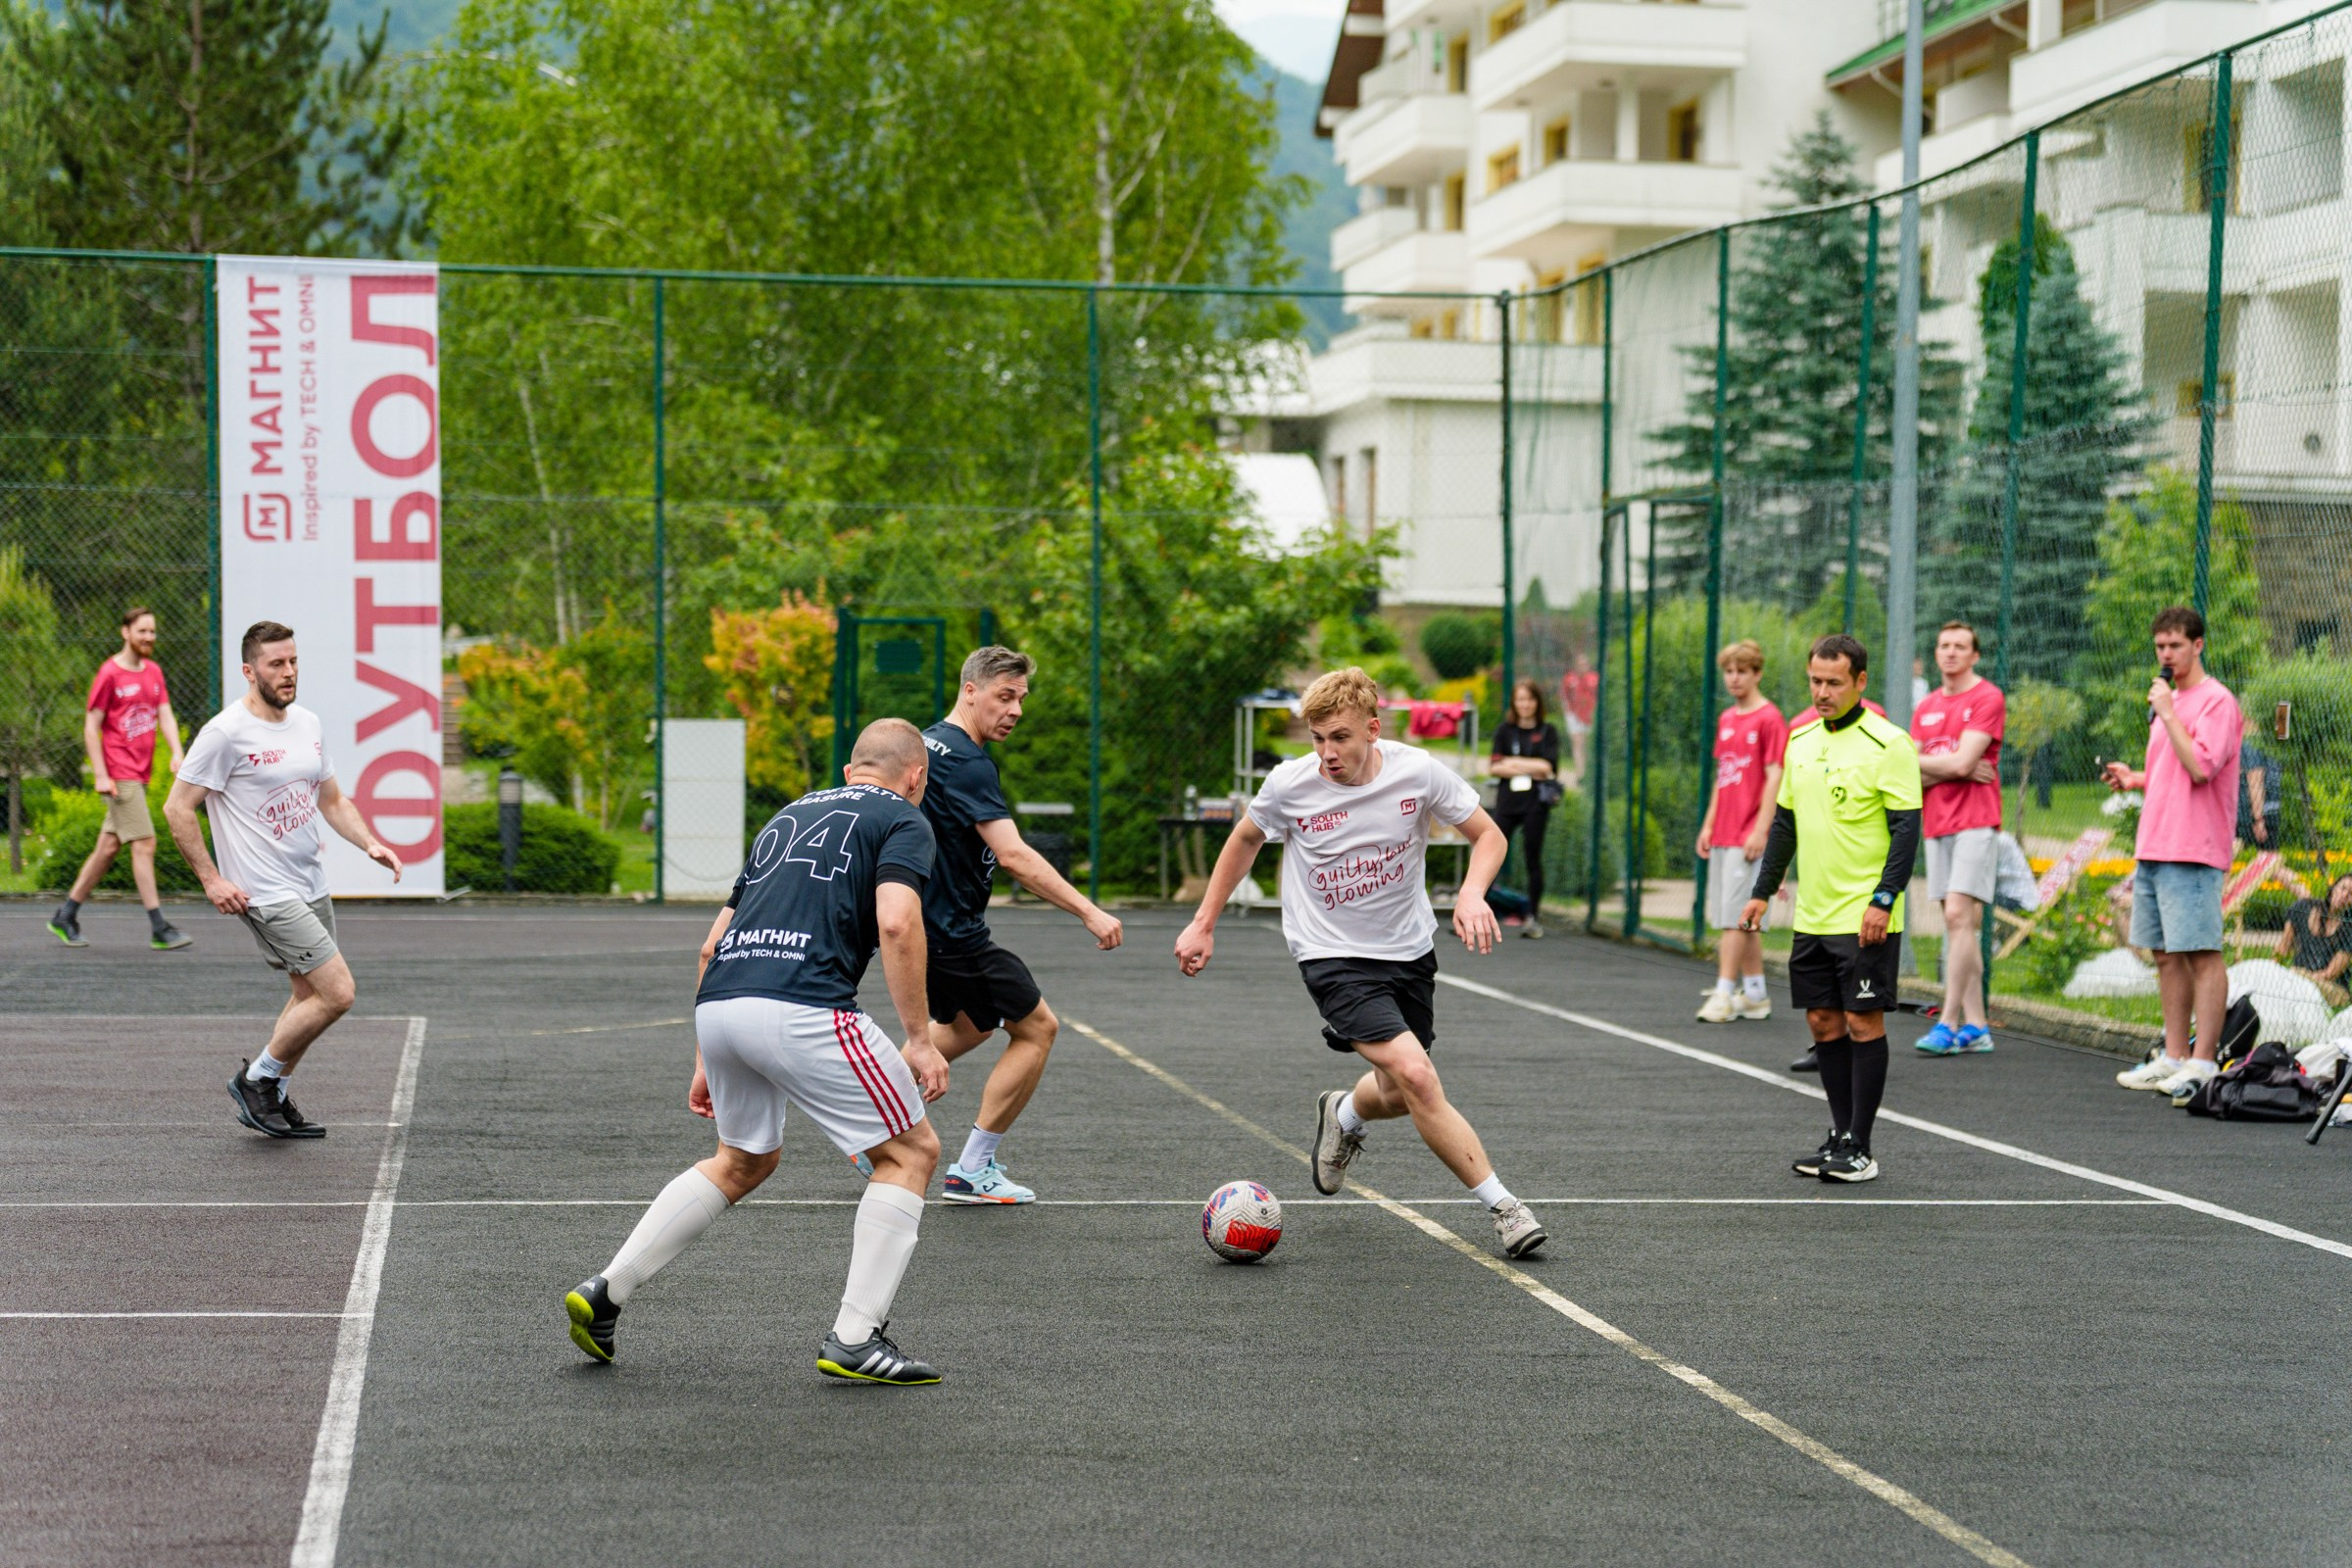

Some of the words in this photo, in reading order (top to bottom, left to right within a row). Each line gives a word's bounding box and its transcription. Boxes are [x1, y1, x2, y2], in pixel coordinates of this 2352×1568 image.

[298, 274, 317, 334] OMNI
[299, 339, 317, 354] &
[247, 275, 284, 476] МАГНИТ
[299, 360, 318, 418] TECH
[300, 425, 320, 449] by
[300, 455, 321, 541] Inspired
[348, 274, 443, 864] ФУТБОЛ
[262, 748, 287, 759] SOUTH
[786, 791, 865, 807] LEASURE
[1310, 811, 1348, 824] SOUTH
[1312, 822, 1334, 833] HUB
[745, 809, 859, 885] 04
[1325, 862, 1404, 911] glowing
[737, 928, 811, 948] МАГНИТ
[740, 949, 750, 959] by
[751, 949, 772, 957] TECH
[773, 950, 780, 958] &
[781, 951, 806, 961] OMNI
